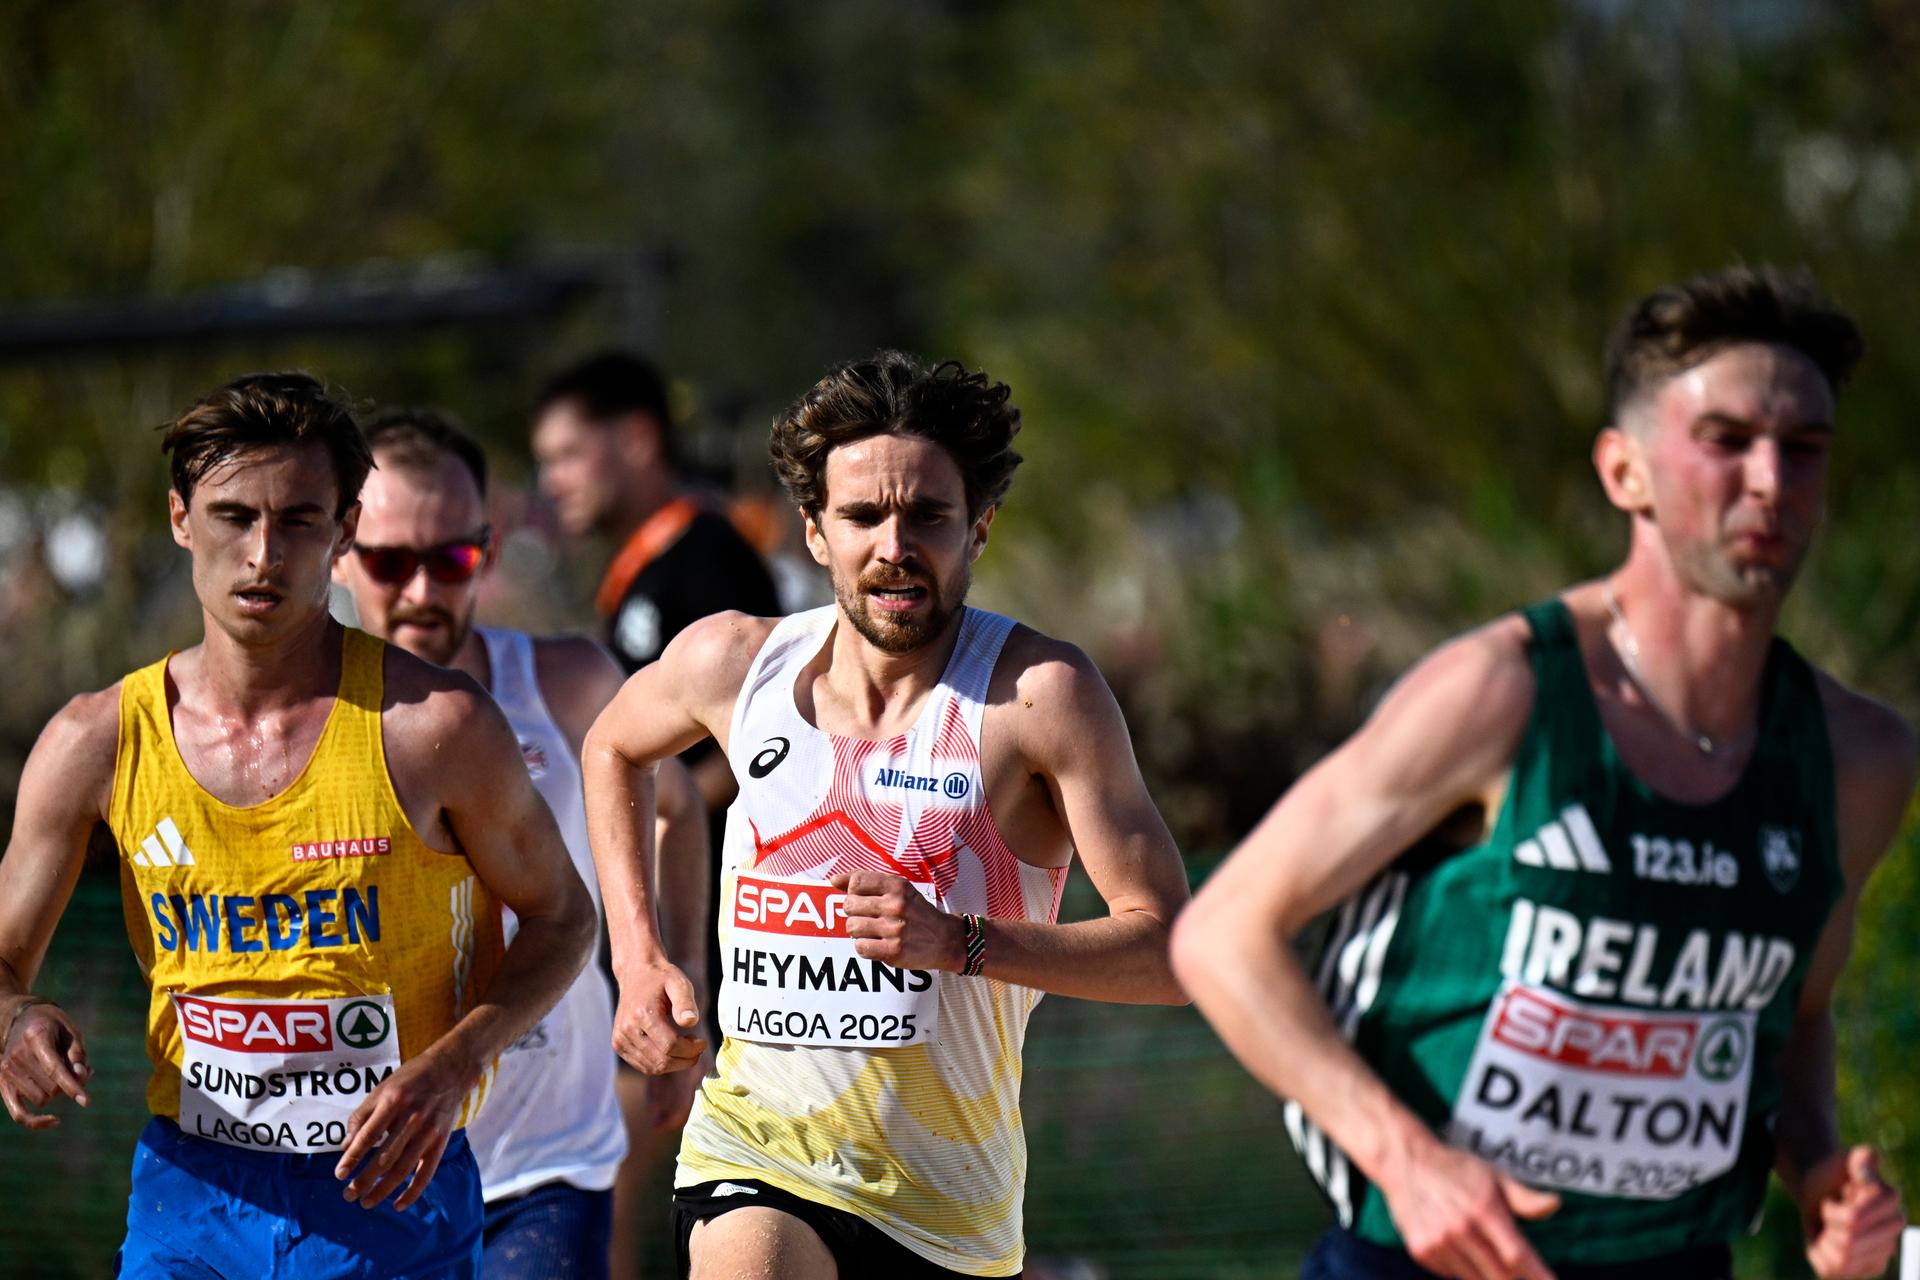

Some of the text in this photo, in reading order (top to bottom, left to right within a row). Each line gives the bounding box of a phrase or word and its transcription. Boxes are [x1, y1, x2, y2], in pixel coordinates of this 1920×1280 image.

[874, 767, 939, 792] Allianz
[292, 838, 390, 861] BAUHAUS
[1630, 831, 1739, 888] 123.ie
[151, 885, 381, 953] SWEDEN
[733, 947, 933, 993] HEYMANS
[1499, 896, 1796, 1010] IRELAND
[183, 1002, 328, 1046] SPAR
[737, 1006, 917, 1041] LAGOA 2025
[1497, 996, 1691, 1072] SPAR
[187, 1061, 394, 1100] SUNDSTRÖM
[1475, 1063, 1737, 1148] DALTON
[196, 1113, 346, 1147] LAGOA 20
[1469, 1127, 1606, 1184] LAGOA
